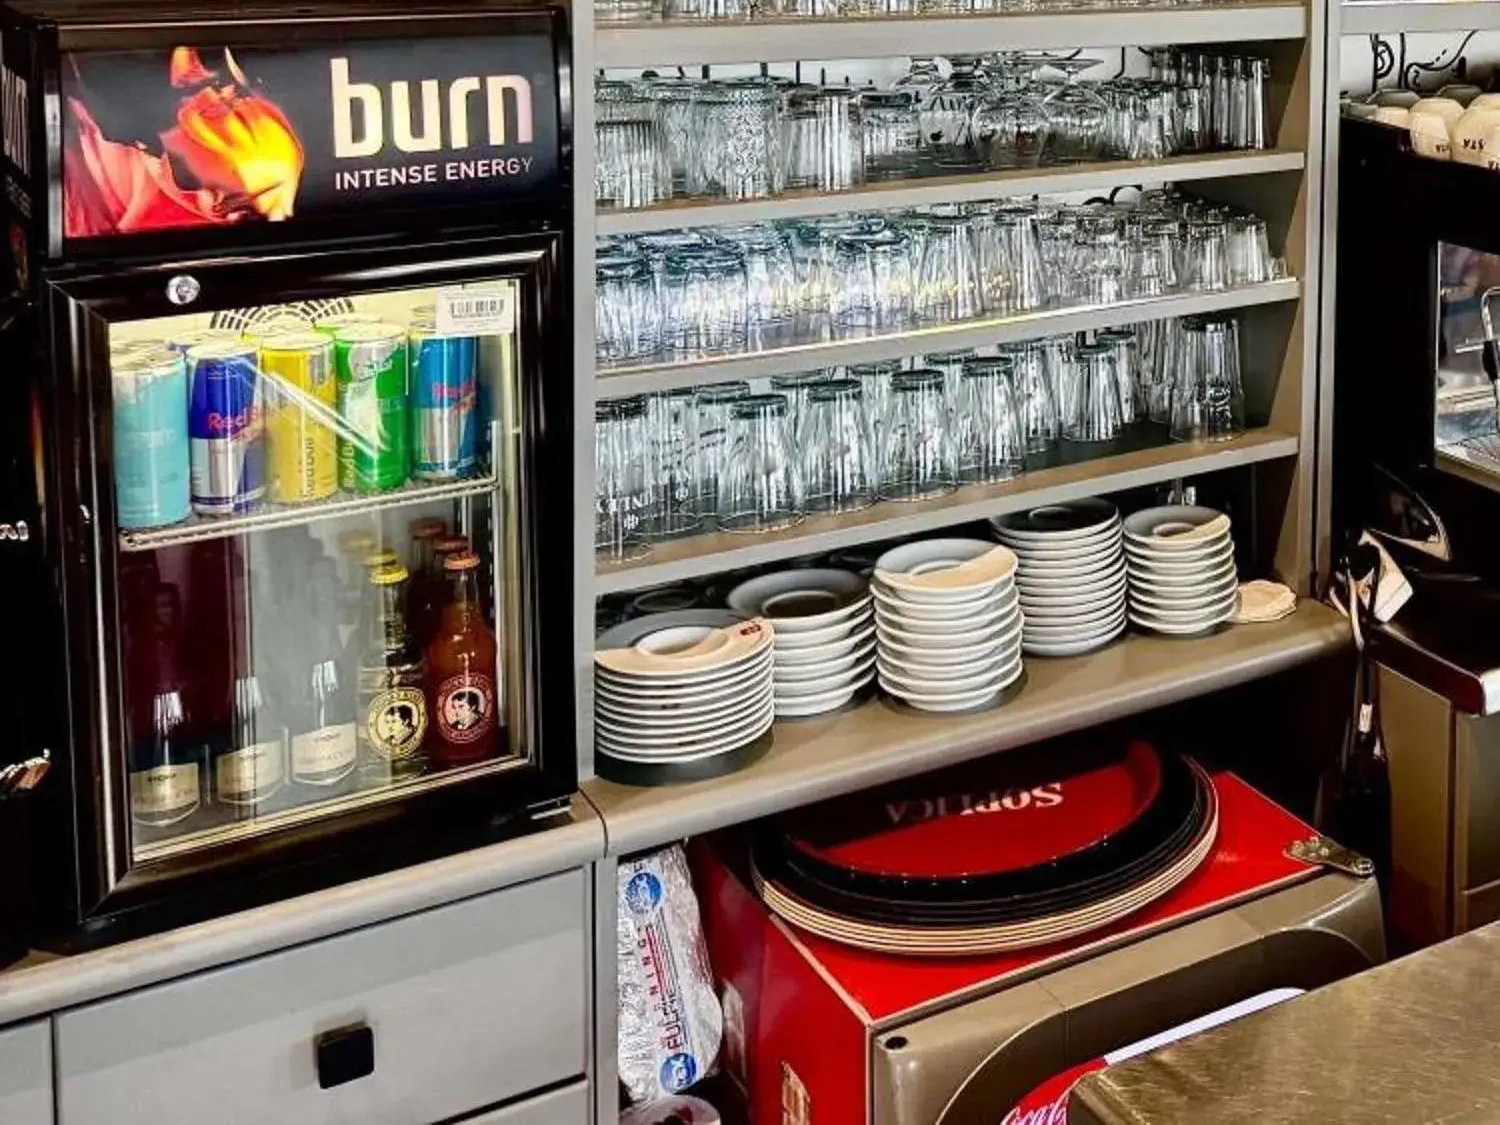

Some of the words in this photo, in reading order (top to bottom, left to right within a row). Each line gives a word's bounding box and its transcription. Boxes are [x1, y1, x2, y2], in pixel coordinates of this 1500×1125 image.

[331, 57, 534, 158] burn
[335, 164, 437, 190] INTENSE
[445, 156, 534, 181] ENERGY
